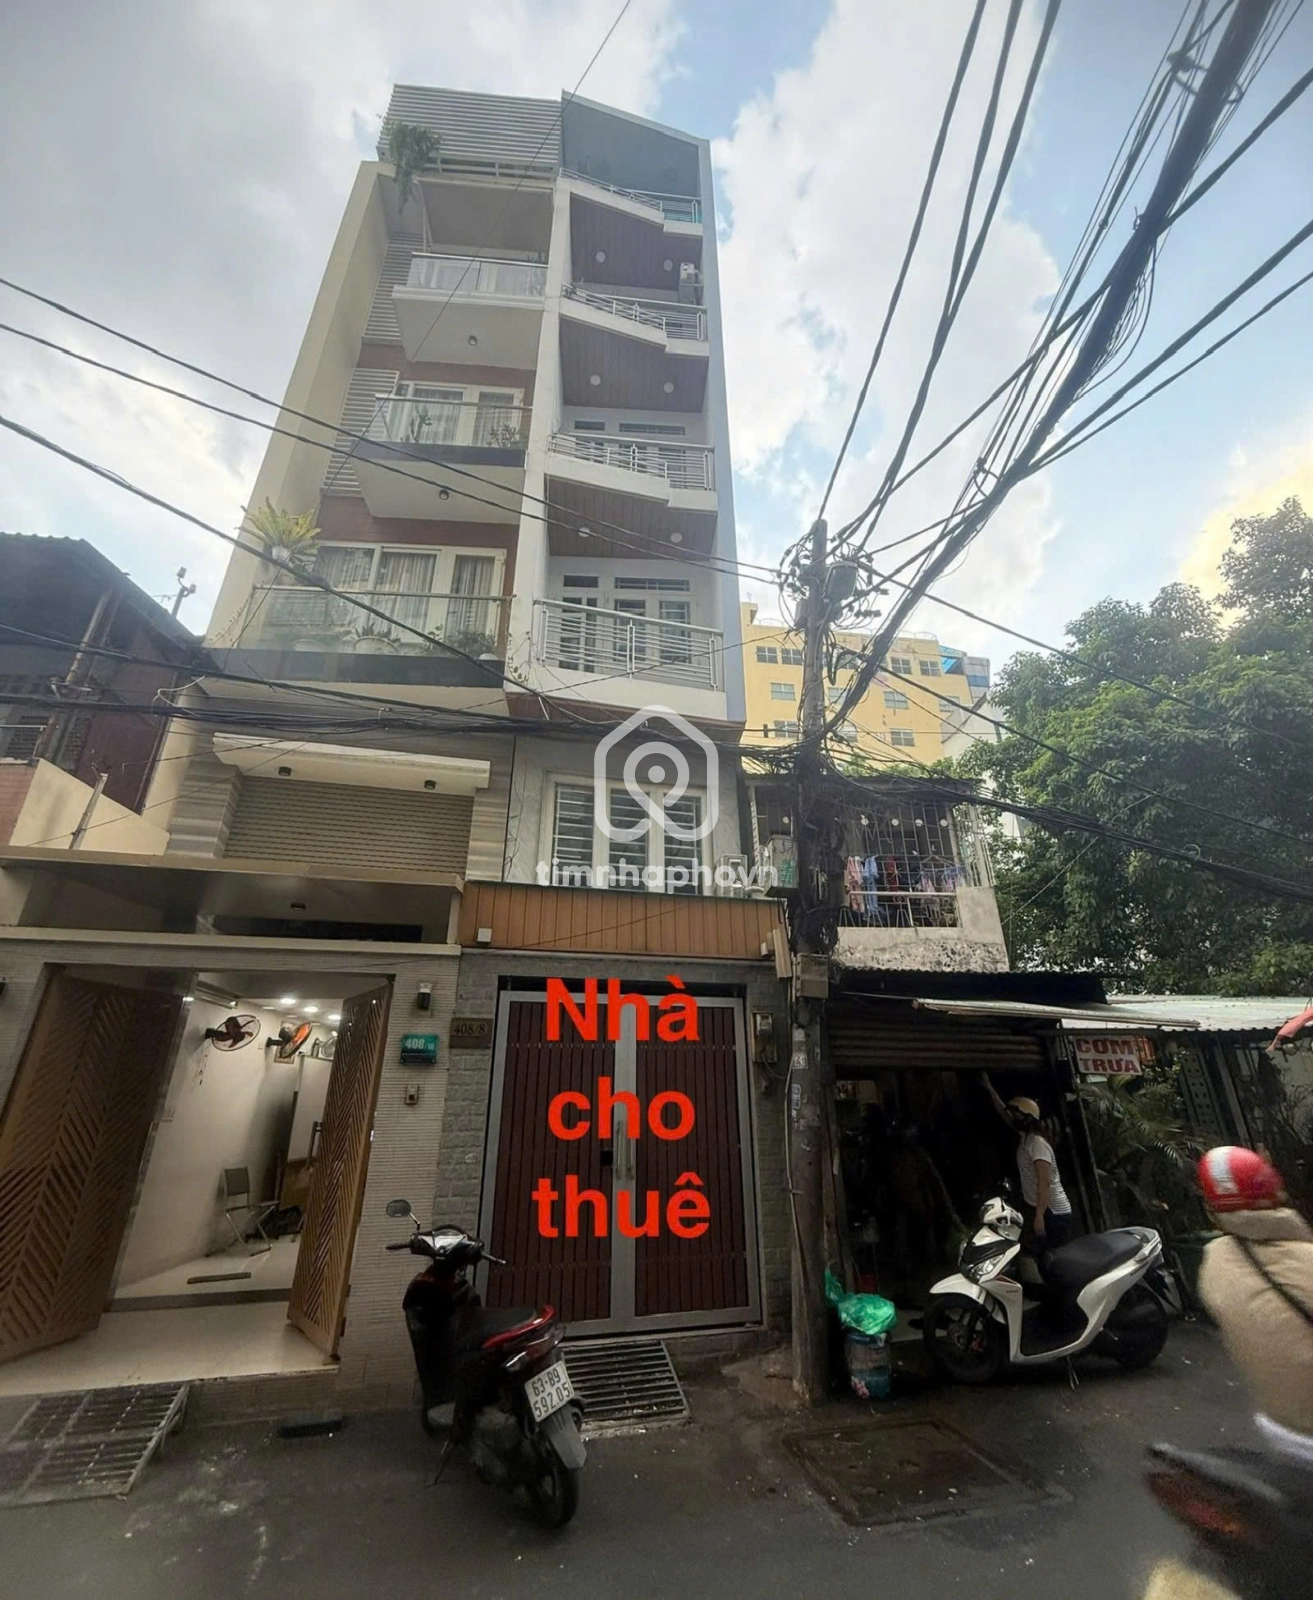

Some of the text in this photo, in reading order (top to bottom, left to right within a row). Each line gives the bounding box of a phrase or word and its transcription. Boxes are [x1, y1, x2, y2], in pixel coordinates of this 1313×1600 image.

[453, 1023, 486, 1037] 408/8
[1079, 1057, 1140, 1074] TRƯA
[532, 1382, 571, 1418] 592.05
